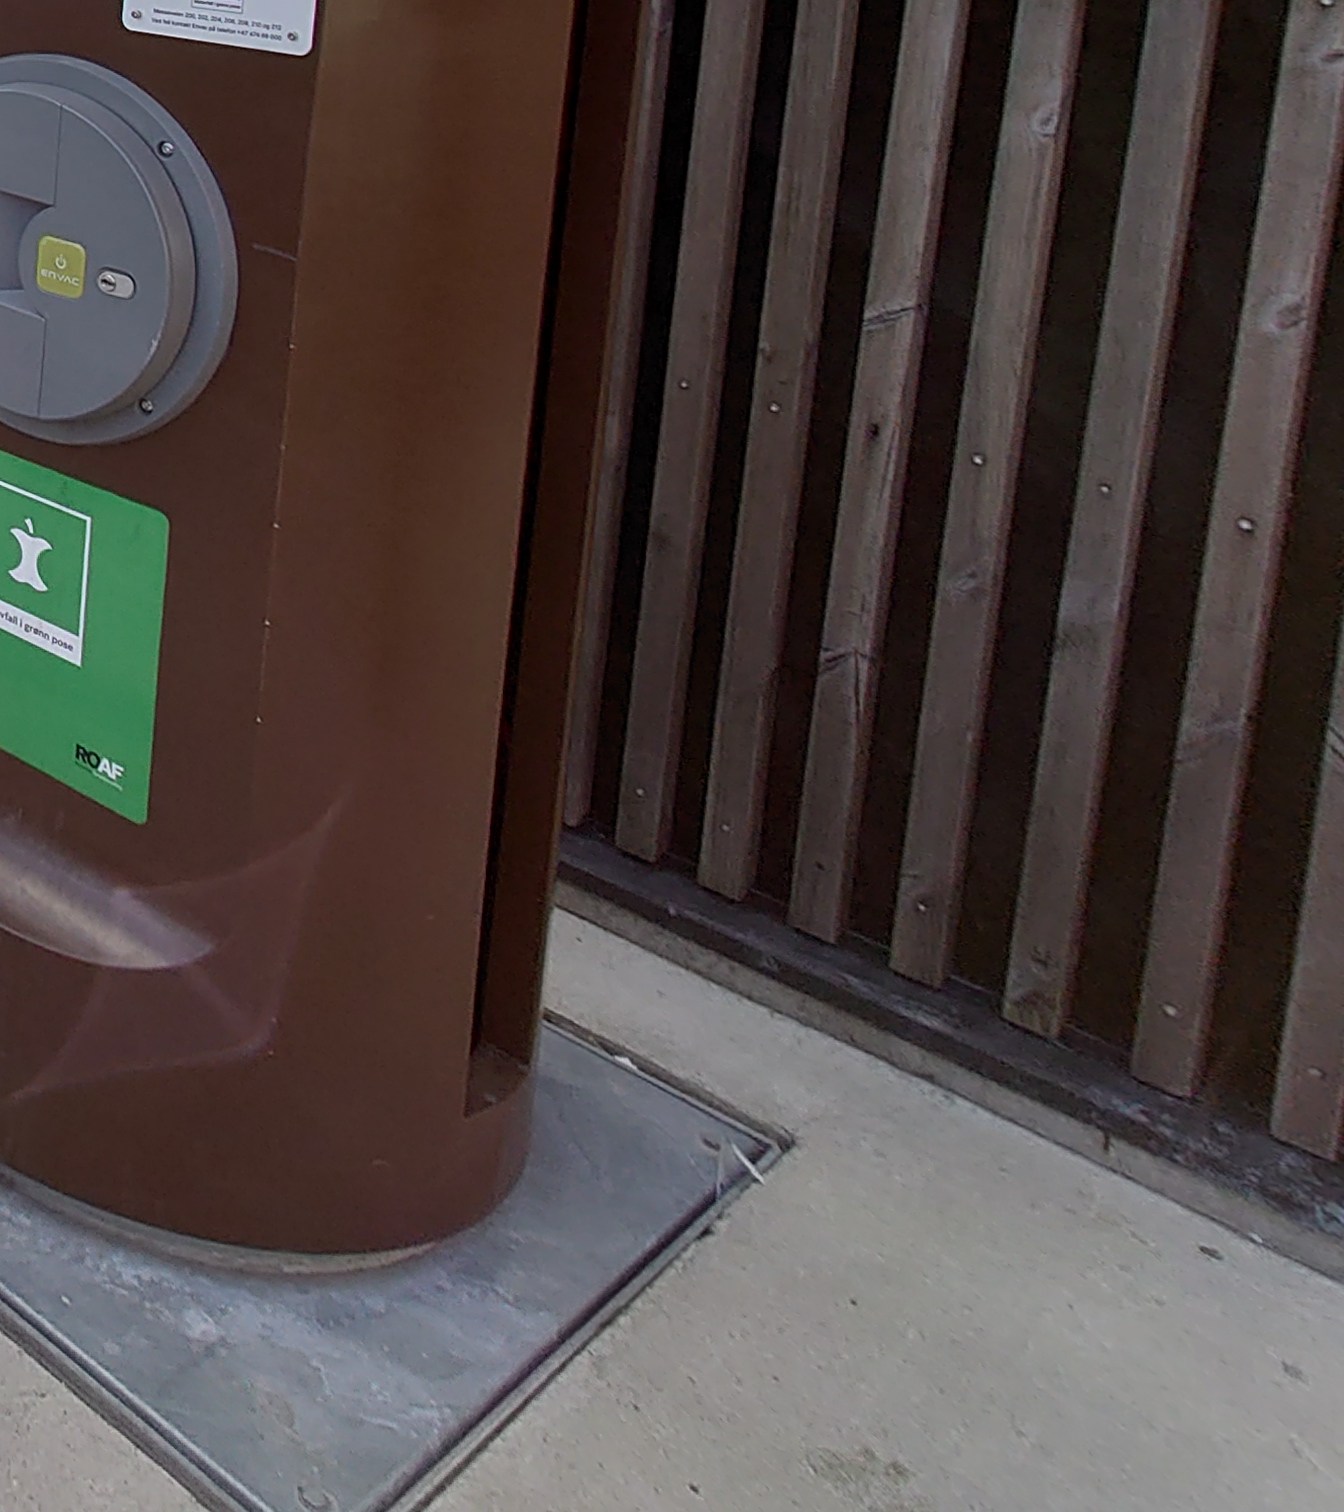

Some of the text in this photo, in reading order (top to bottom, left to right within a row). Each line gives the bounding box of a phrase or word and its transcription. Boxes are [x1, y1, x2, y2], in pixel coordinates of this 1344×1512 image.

[41, 269, 80, 286] ENVAC
[19, 619, 23, 628] i
[24, 624, 50, 641] grønn
[51, 636, 74, 652] pose
[75, 743, 124, 781] ROAF
